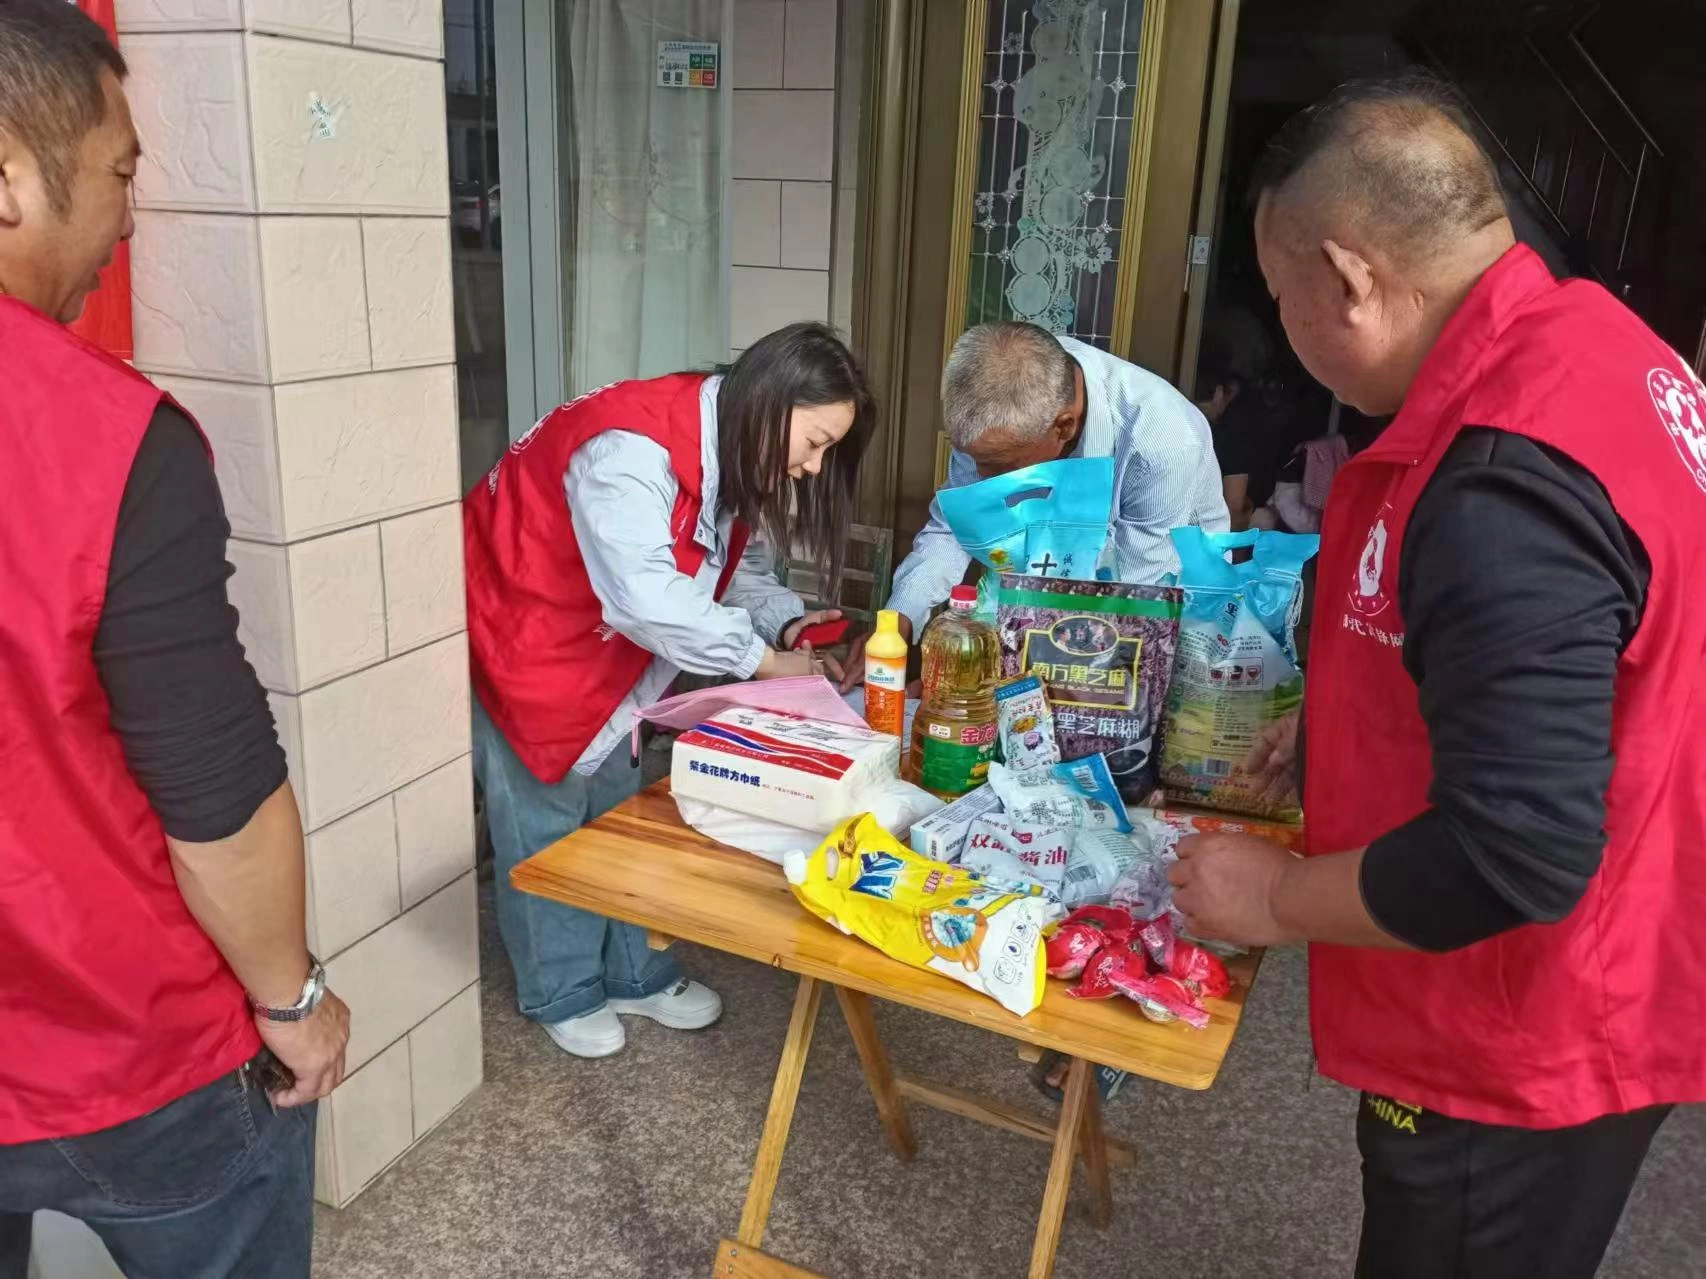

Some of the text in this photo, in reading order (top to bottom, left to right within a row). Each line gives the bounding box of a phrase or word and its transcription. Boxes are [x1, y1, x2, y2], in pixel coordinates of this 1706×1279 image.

[1057, 712, 1140, 739] 黑芝麻糊
[688, 760, 761, 788] 紫金花牌方巾纸
